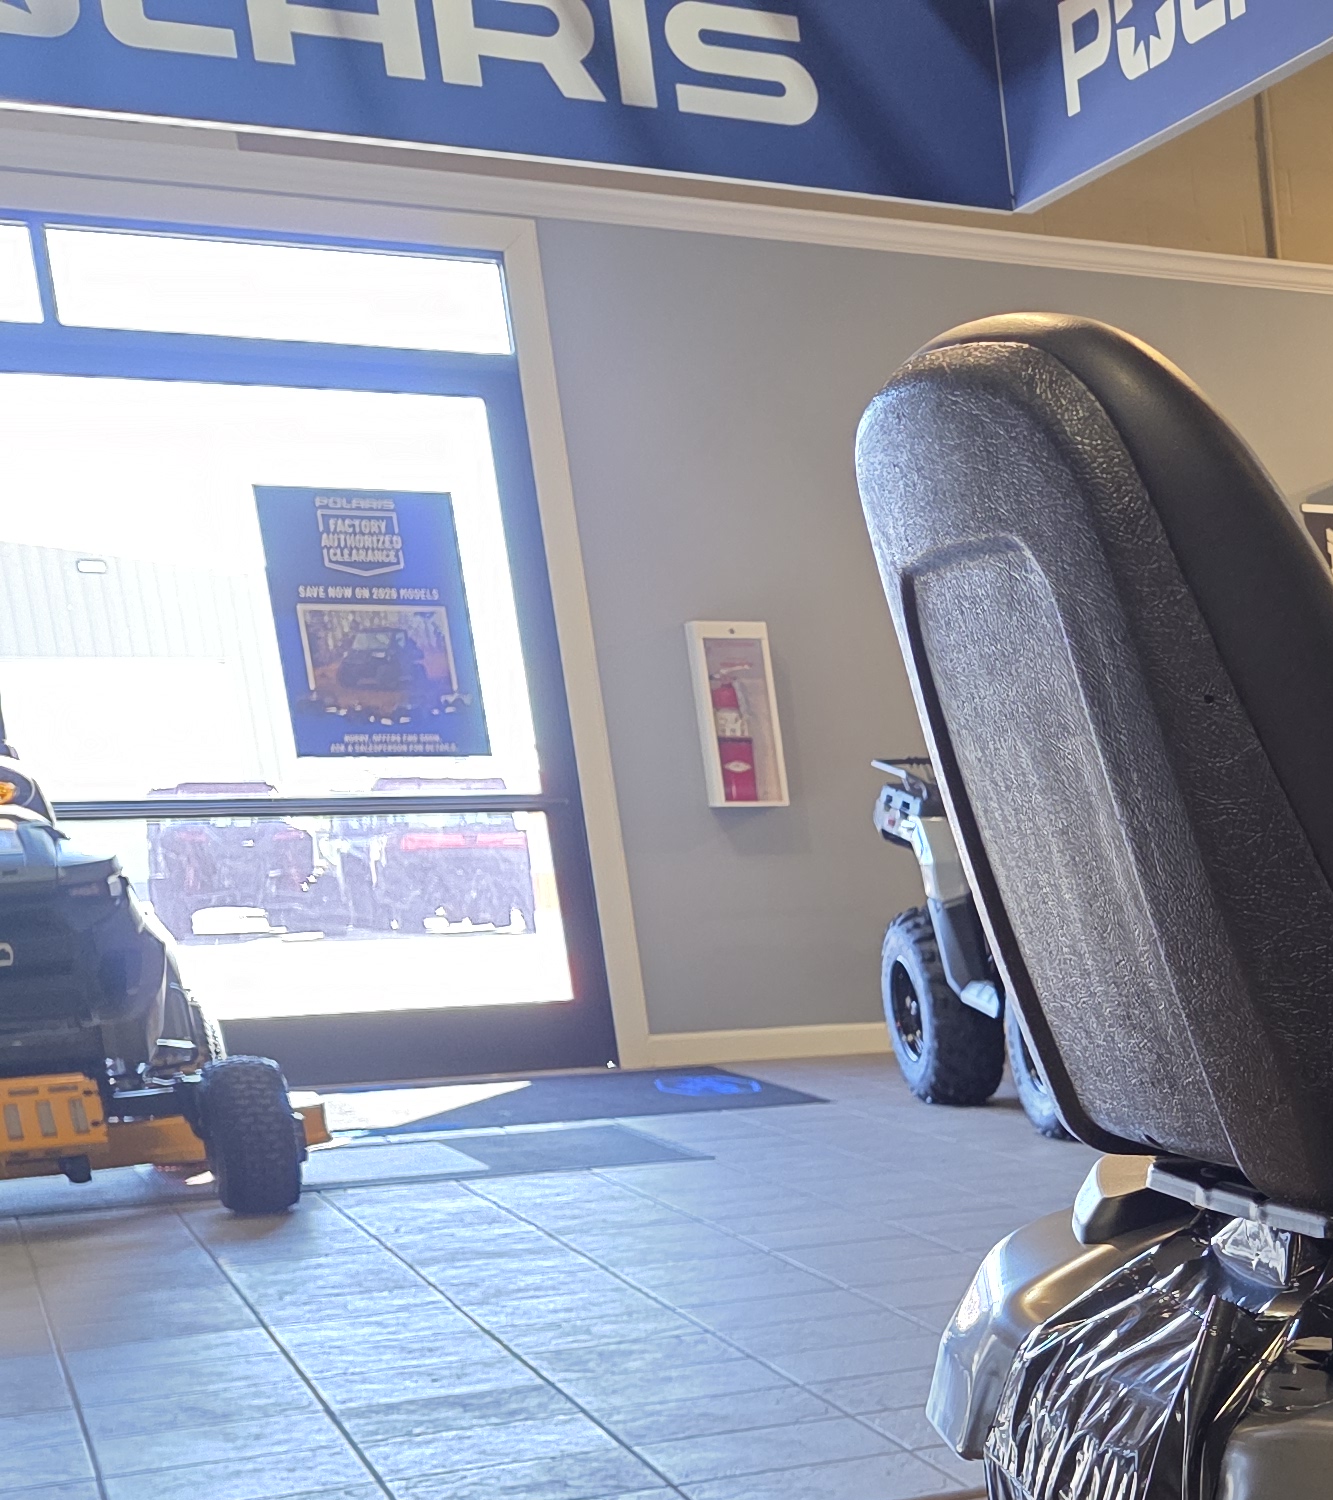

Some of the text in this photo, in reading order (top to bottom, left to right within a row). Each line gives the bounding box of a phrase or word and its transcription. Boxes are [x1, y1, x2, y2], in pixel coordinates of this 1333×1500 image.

[0, 0, 818, 126] LARIS
[315, 496, 395, 510] POLARIS
[329, 518, 386, 534] FACTORY
[321, 532, 402, 549] AUTHORIZED
[329, 547, 397, 563] CLEARANCE
[298, 585, 325, 599] SAVE
[328, 586, 352, 599] NOW
[355, 586, 370, 599] ON
[400, 588, 439, 600] MODELS
